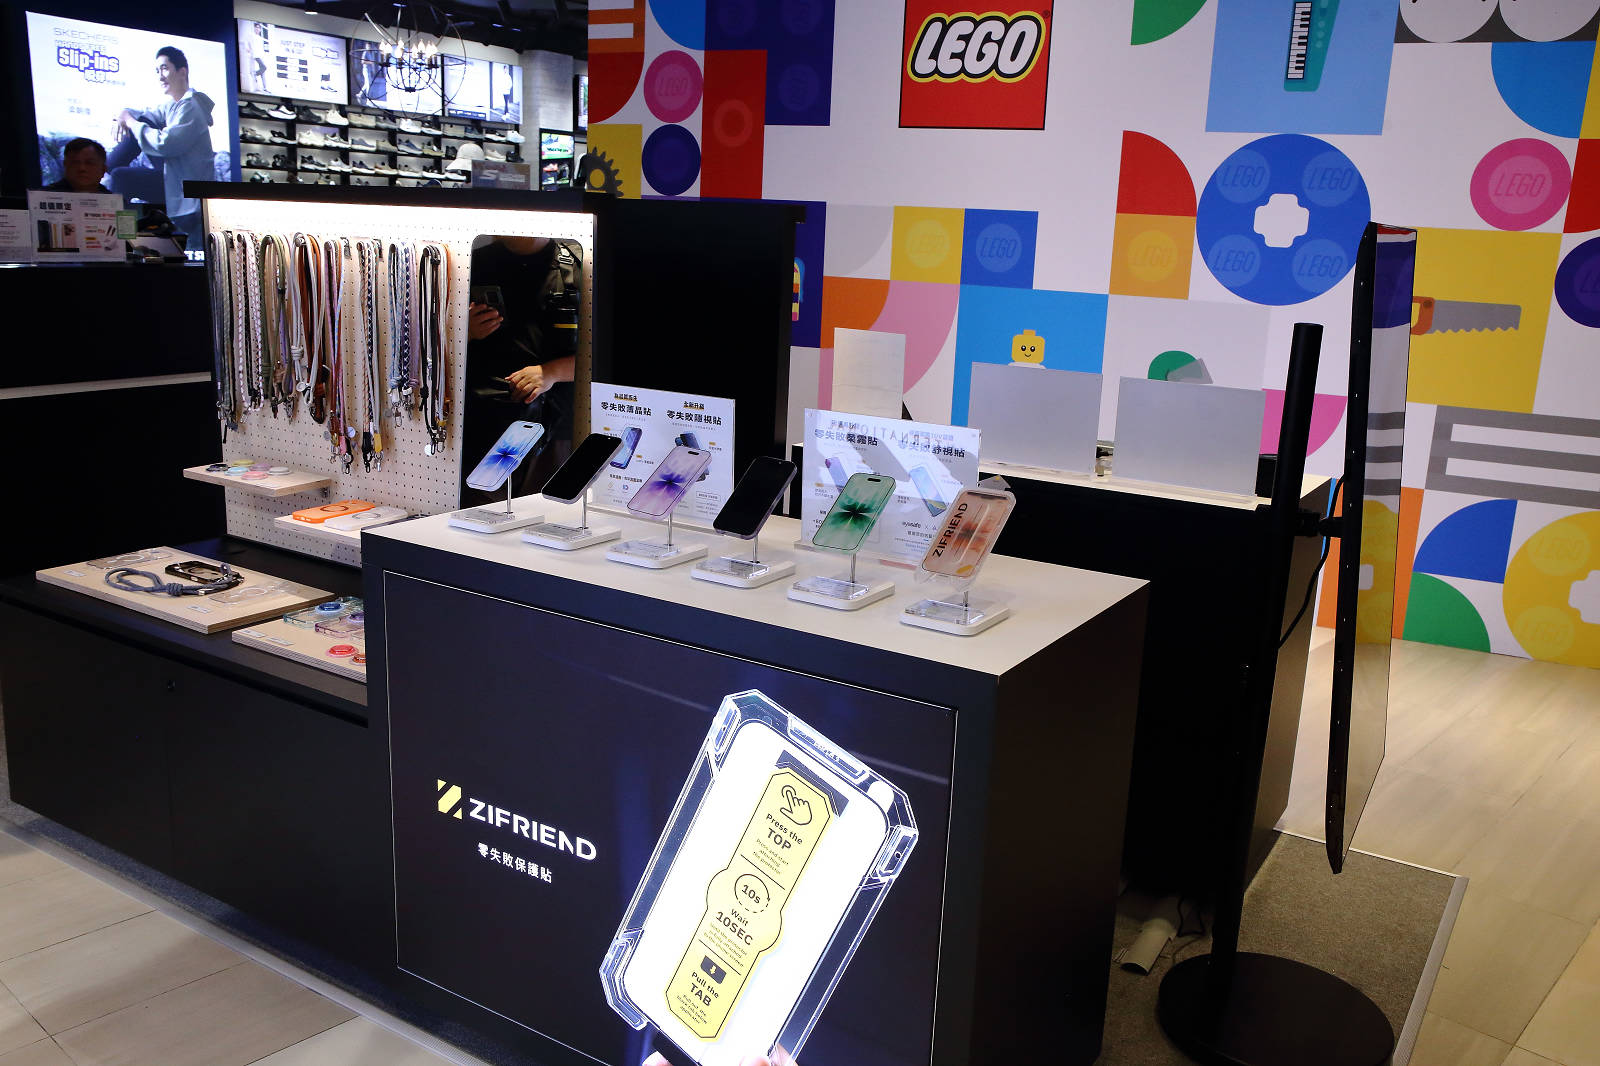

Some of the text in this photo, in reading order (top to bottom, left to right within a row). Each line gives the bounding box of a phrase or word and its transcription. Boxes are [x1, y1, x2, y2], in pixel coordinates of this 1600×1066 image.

[58, 46, 119, 72] Slip-ins
[910, 15, 1042, 79] LEGO
[1221, 164, 1266, 187] LEGO
[1307, 166, 1352, 191] LEGO
[1494, 172, 1546, 198] LEGO
[980, 236, 1018, 258] LEGO
[1213, 249, 1255, 273] LEGO
[1300, 253, 1344, 278] LEGO
[932, 503, 968, 558] ZIFRIEND
[469, 797, 597, 861] ZIFRIEND
[766, 813, 803, 844] Press the
[768, 827, 791, 849] TOP
[477, 842, 552, 884] 零失敗保護貼
[741, 884, 761, 904] 10s
[716, 911, 754, 946] 10SEC
[690, 982, 712, 1007] TAB
[692, 971, 719, 999] Pull the
